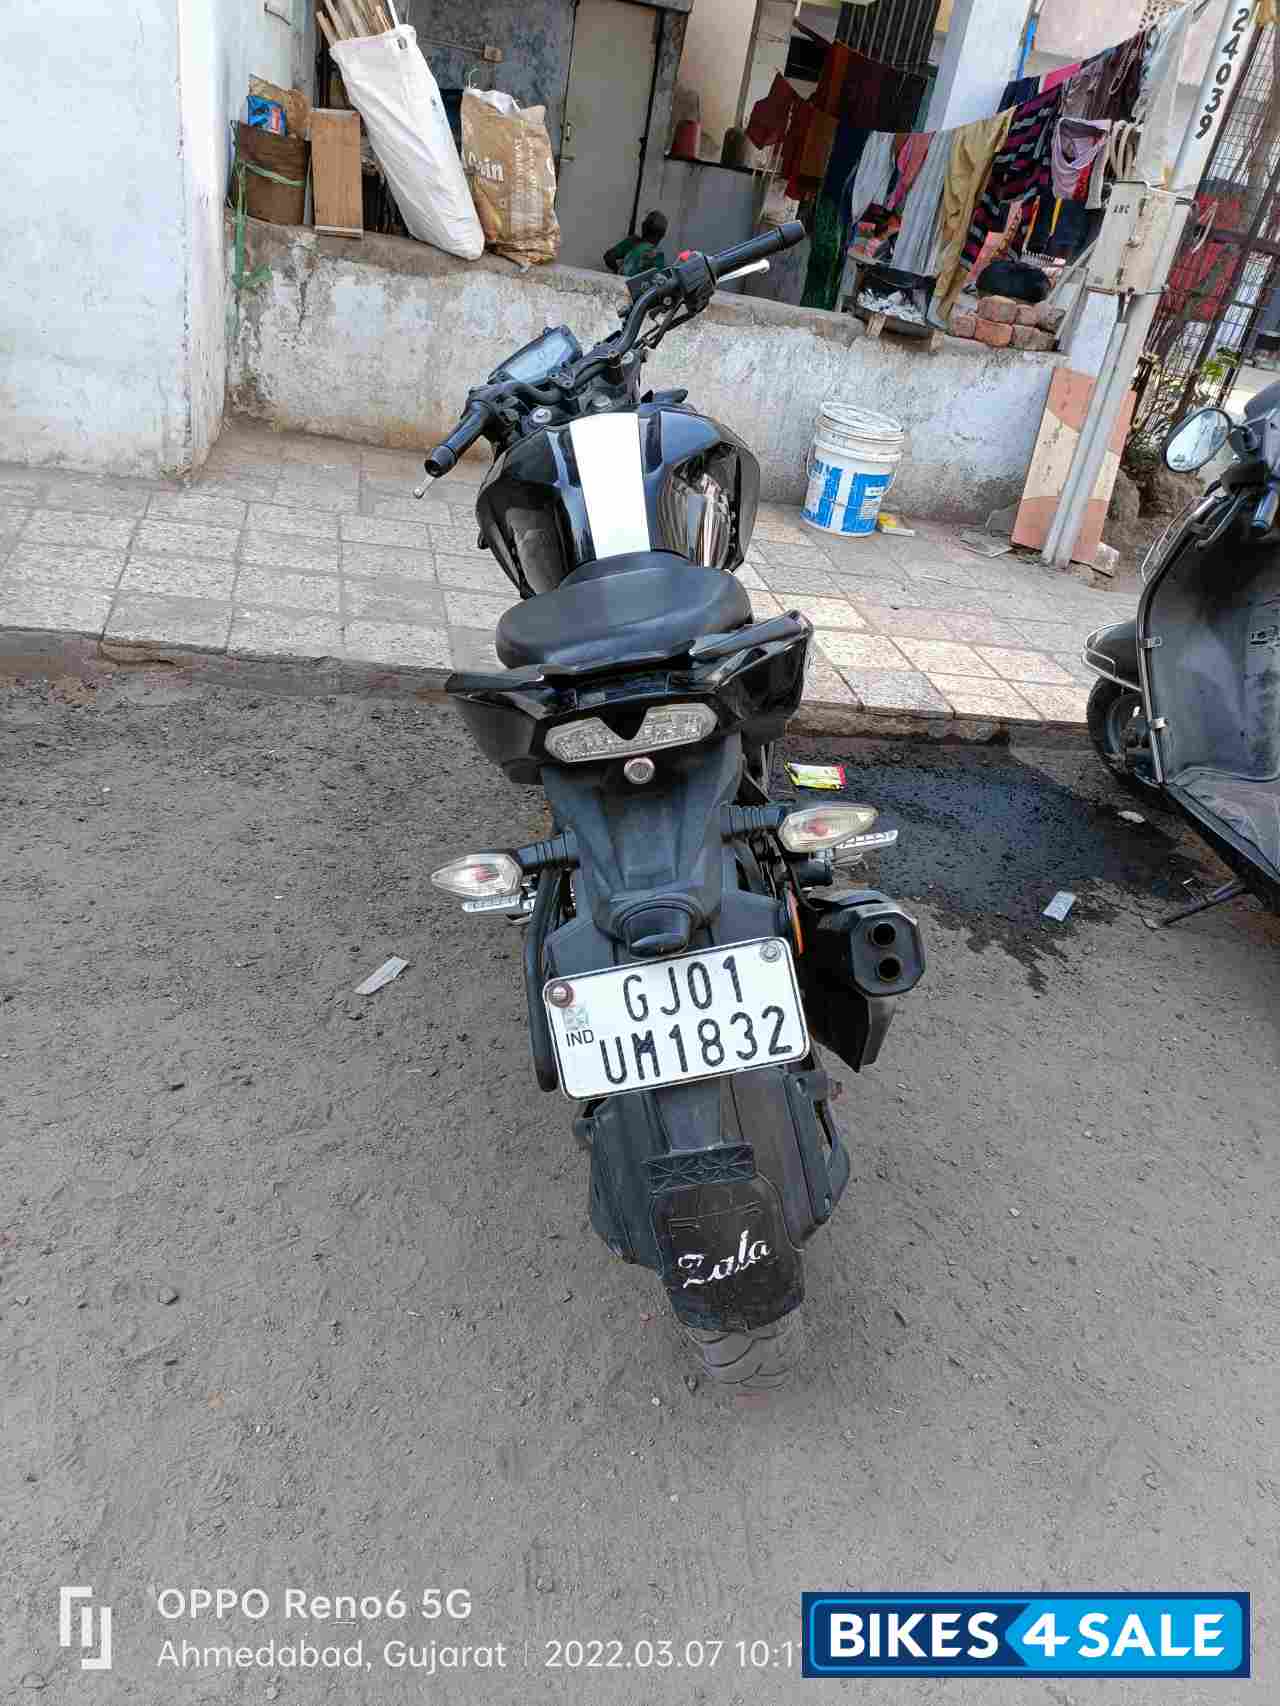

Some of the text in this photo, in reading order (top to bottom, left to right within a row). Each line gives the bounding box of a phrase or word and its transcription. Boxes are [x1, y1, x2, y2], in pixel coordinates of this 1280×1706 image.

[1195, 7, 1250, 139] 24039
[622, 955, 743, 1022] GJ01
[565, 1029, 595, 1047] IND
[599, 1005, 793, 1084] UM1832
